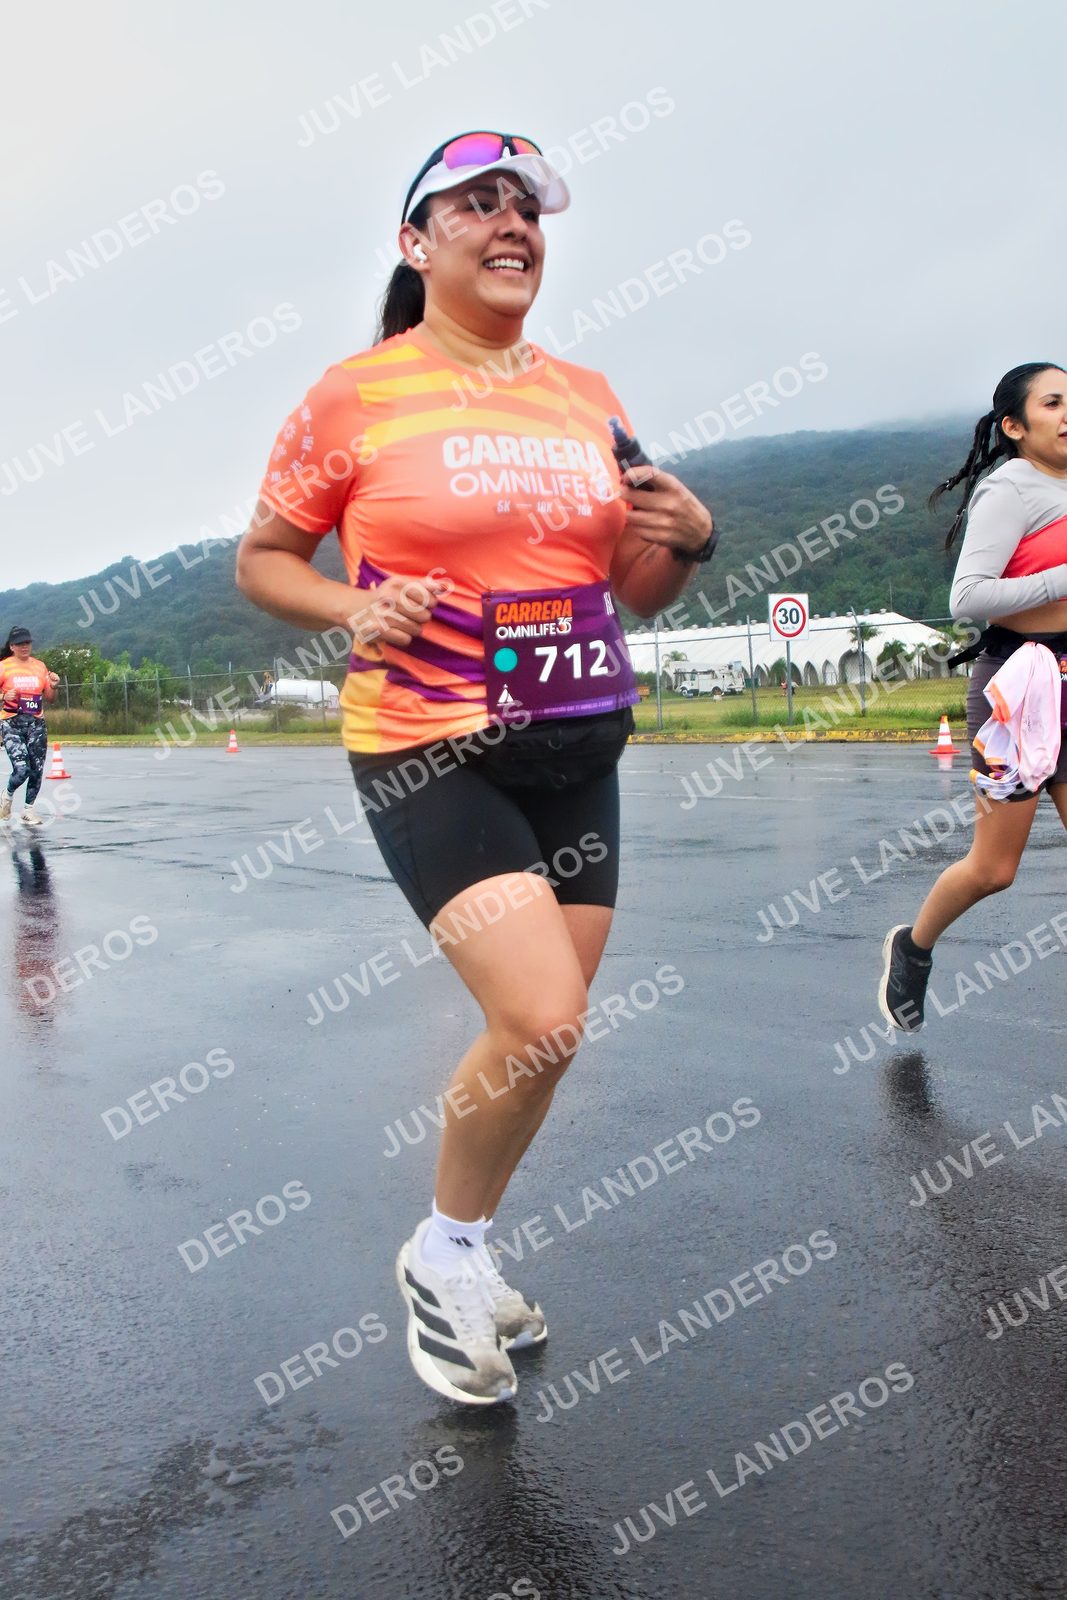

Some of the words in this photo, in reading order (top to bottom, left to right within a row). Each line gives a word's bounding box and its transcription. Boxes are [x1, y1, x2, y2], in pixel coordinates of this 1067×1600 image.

[442, 434, 610, 476] CARRERA
[495, 598, 574, 624] CARRERA
[778, 607, 800, 625] 30
[534, 639, 610, 683] 712
